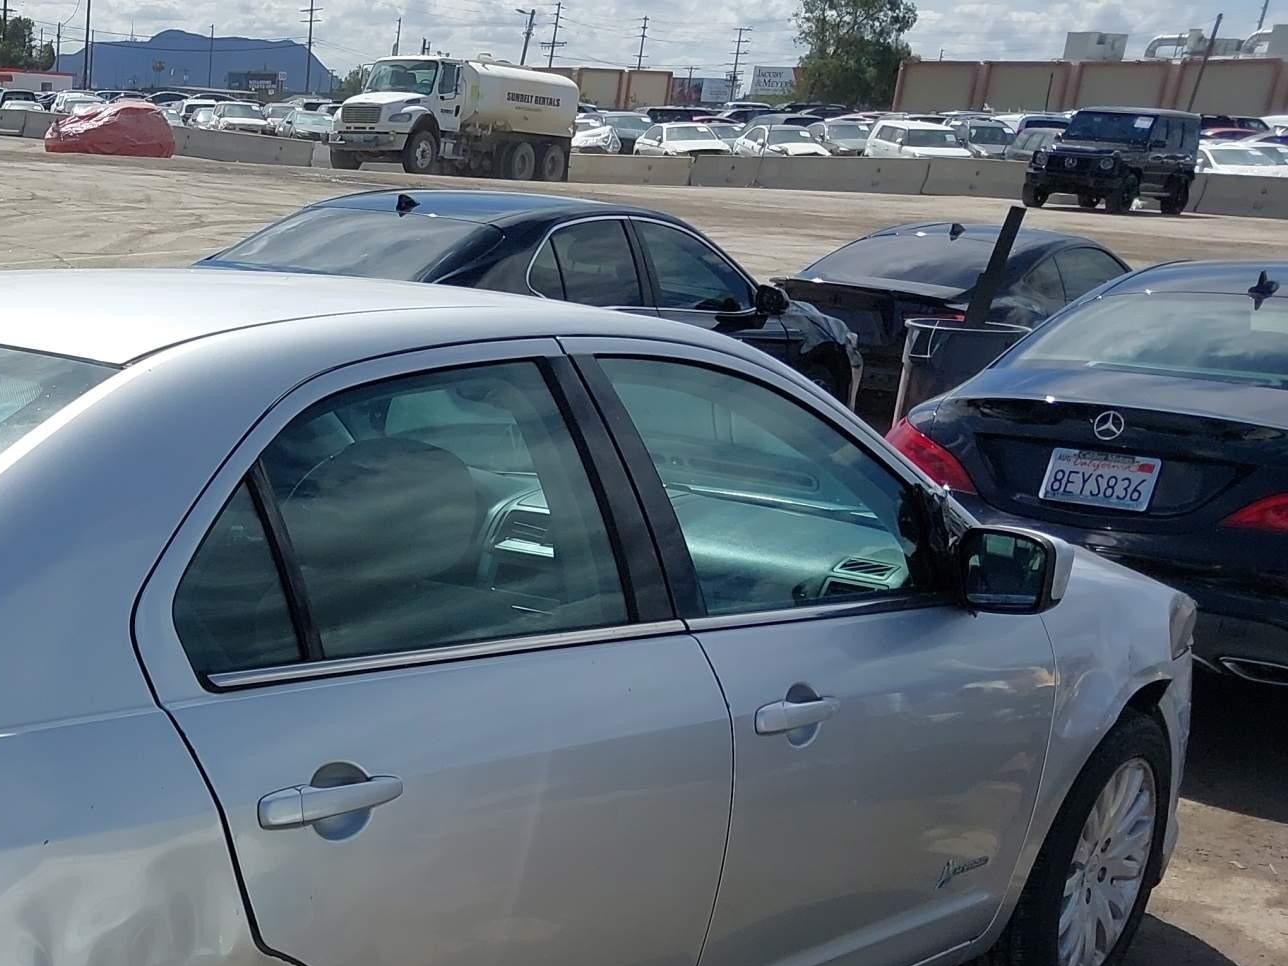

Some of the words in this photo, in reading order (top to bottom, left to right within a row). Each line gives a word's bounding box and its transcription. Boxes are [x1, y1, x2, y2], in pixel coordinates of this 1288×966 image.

[506, 91, 534, 105] SUNBELT
[534, 95, 561, 107] RENTALS
[1050, 468, 1147, 502] 8EYS836
